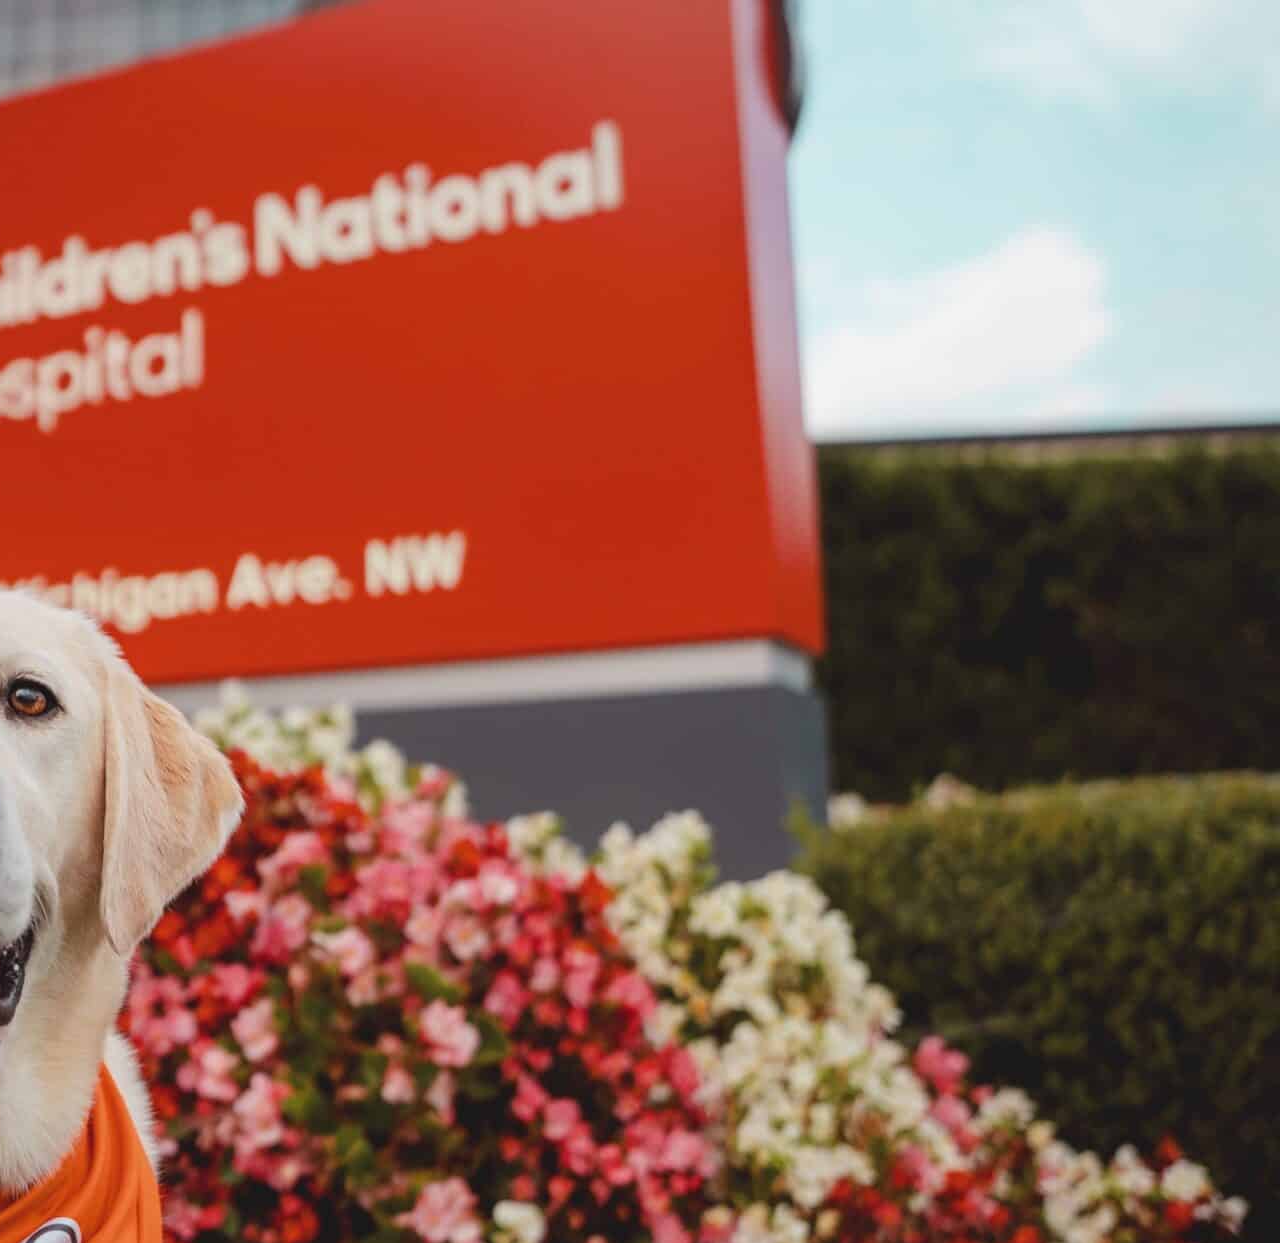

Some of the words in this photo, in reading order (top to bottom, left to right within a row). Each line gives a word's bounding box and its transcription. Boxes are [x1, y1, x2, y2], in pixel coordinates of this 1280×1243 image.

[254, 119, 624, 277] National
[226, 553, 351, 610] Ave.
[364, 531, 467, 597] NW
